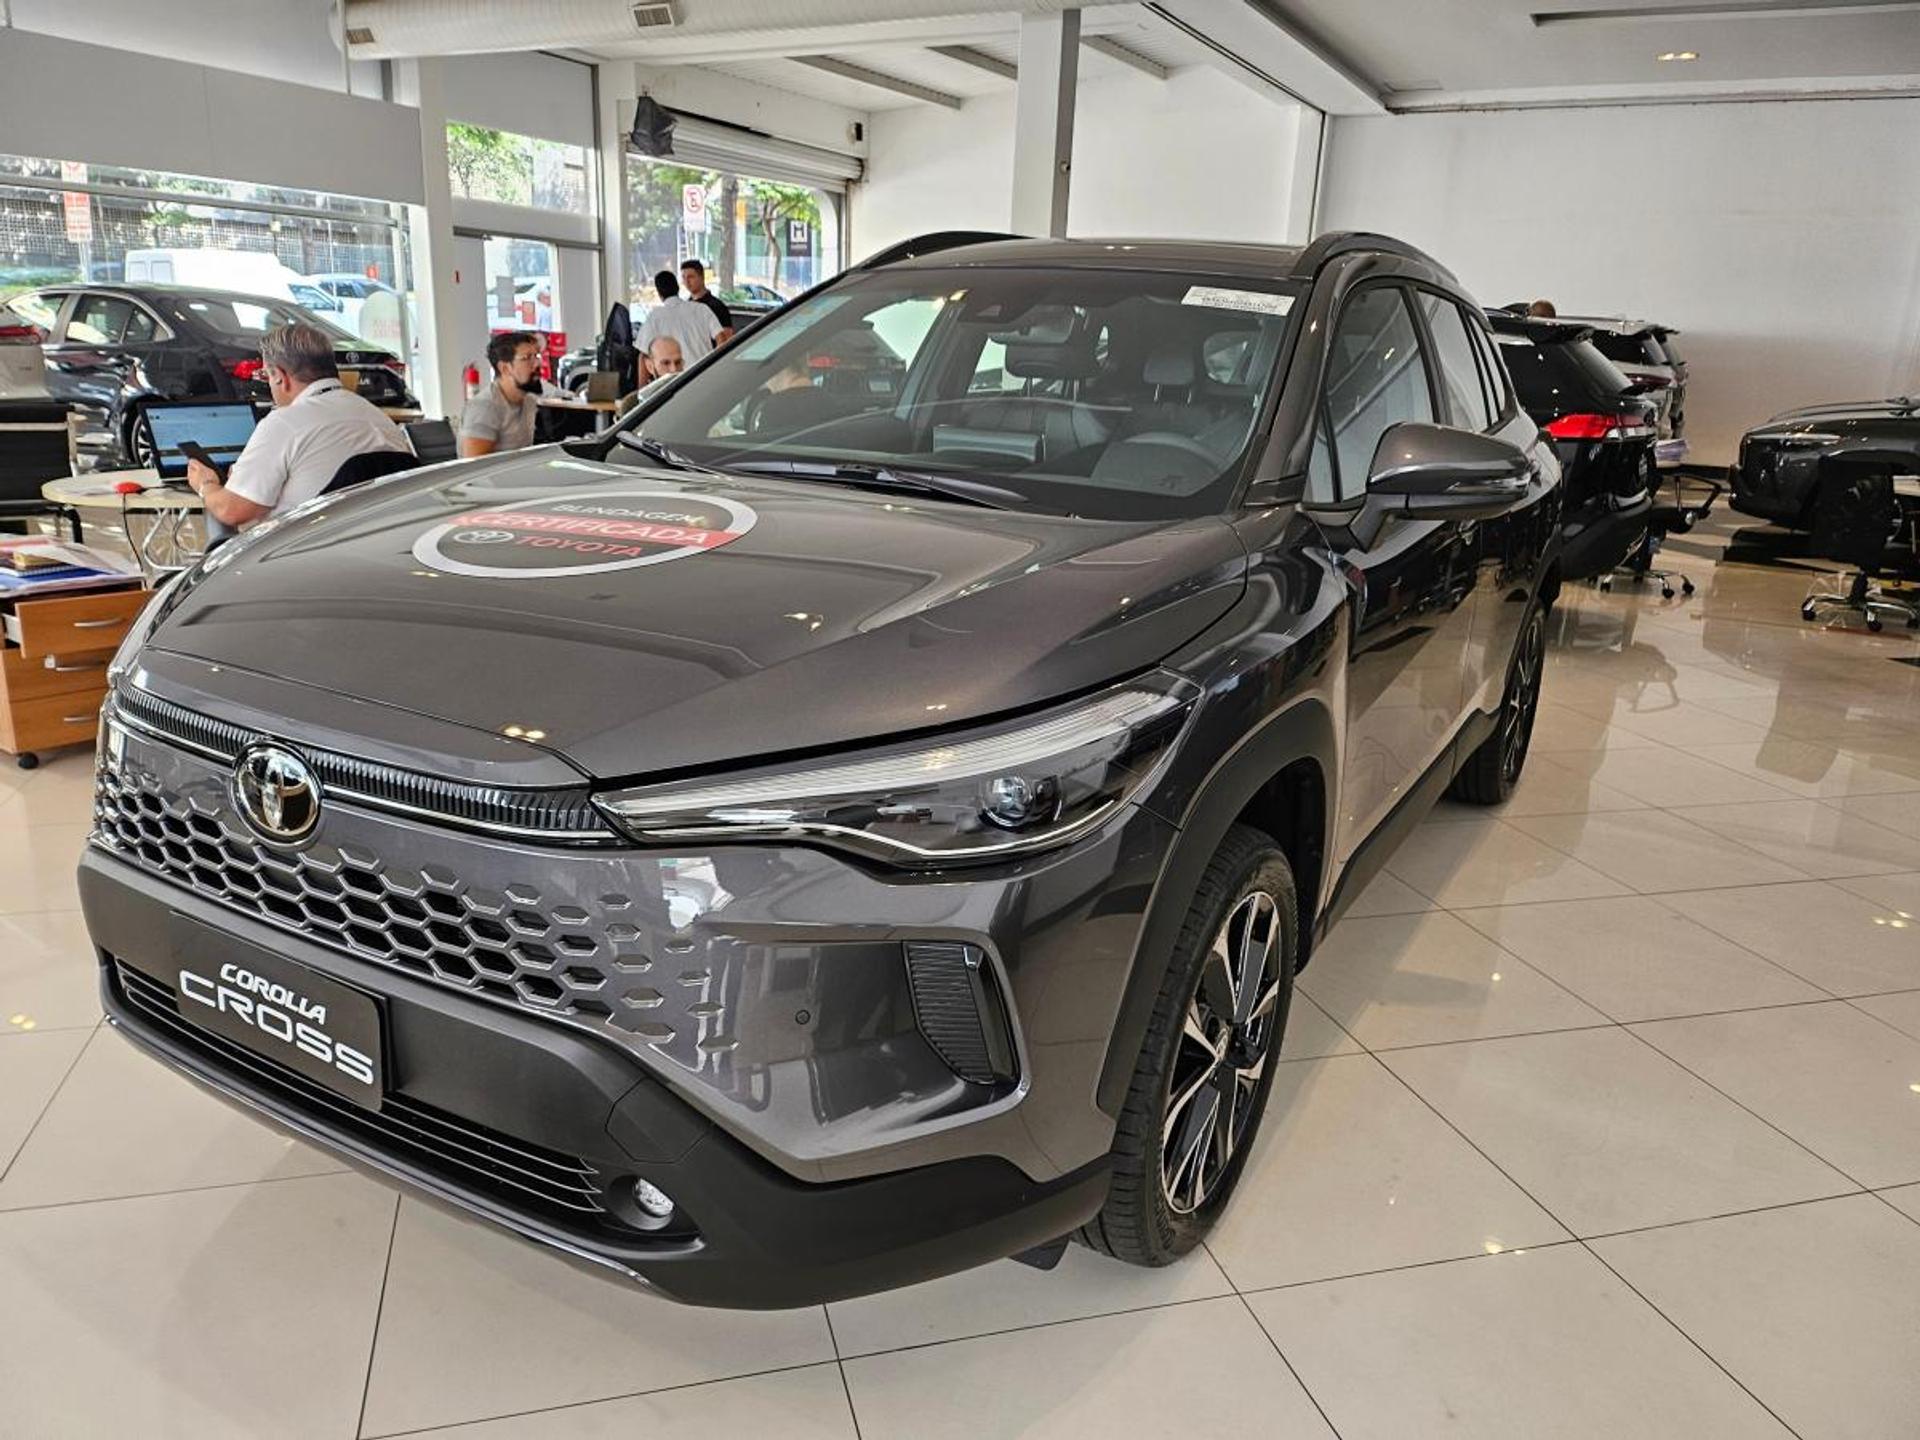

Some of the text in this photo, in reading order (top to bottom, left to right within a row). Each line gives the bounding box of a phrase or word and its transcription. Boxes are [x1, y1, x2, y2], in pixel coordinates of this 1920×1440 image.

[470, 513, 708, 544] CERTIFICADA
[551, 503, 705, 524] BLINDAGEM
[515, 535, 643, 557] TOYOTA
[220, 963, 327, 1025] COROLLA
[179, 969, 374, 1085] CROSS
